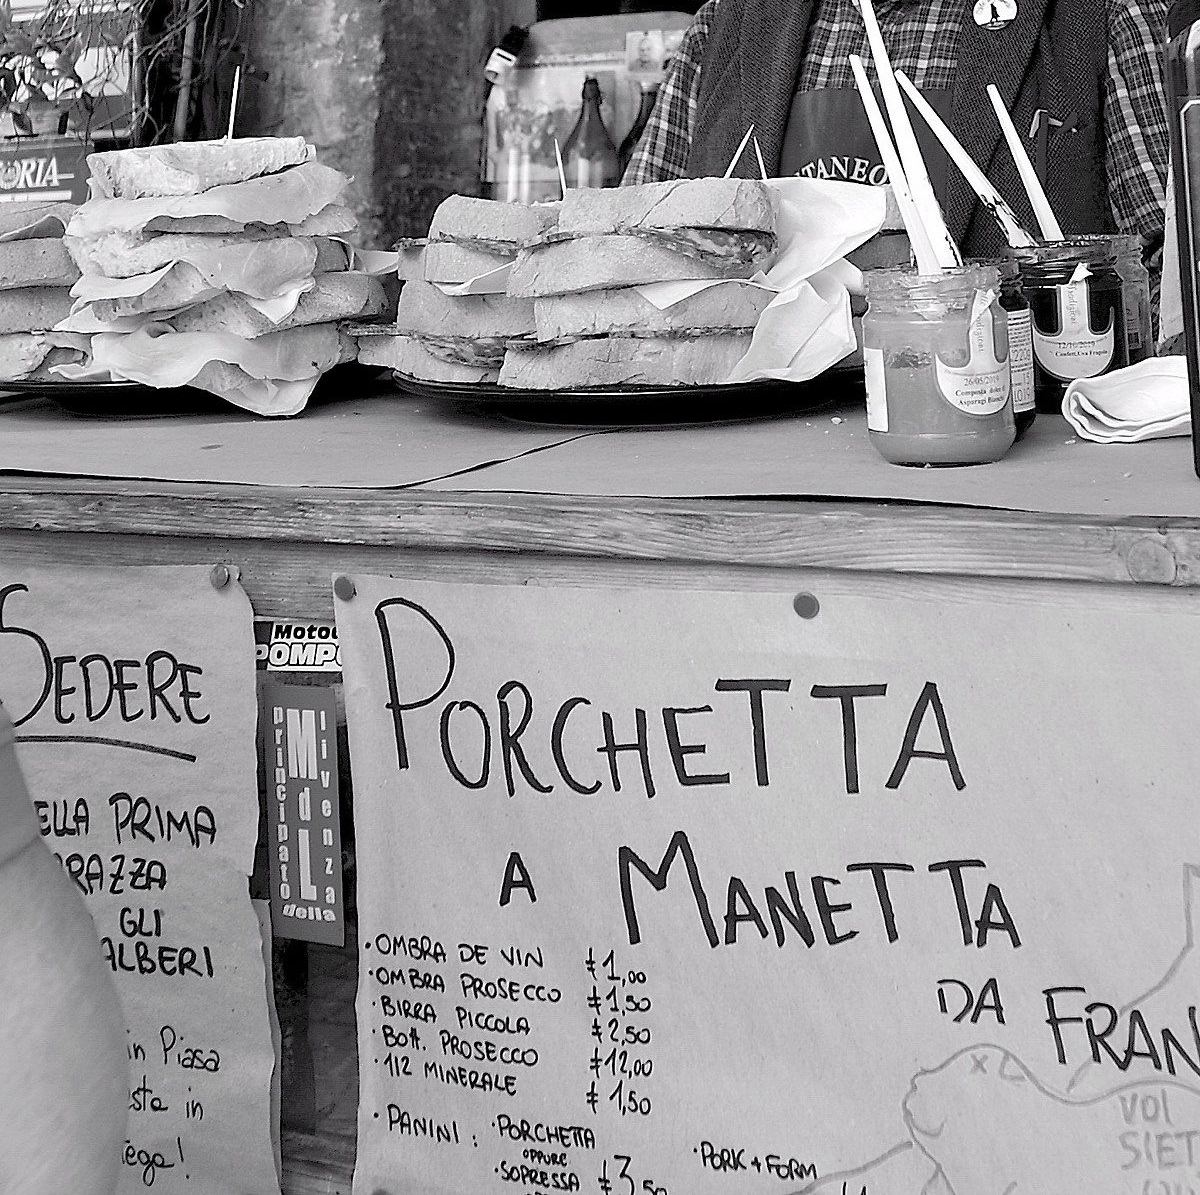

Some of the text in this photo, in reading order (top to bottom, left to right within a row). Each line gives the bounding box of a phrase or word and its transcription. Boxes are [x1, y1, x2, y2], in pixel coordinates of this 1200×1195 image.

[0, 157, 60, 190] ORIA
[794, 155, 889, 186] TANEO
[0, 583, 210, 728] SEDERE
[255, 642, 341, 667] POMP
[376, 597, 967, 798] PORCHETTA
[108, 791, 217, 848] PRIMA
[55, 852, 168, 895] RAZZA
[499, 830, 1023, 949] A MANETTA
[119, 906, 163, 938] GLI
[282, 904, 336, 922] della
[100, 936, 214, 977] ALBERI
[375, 933, 447, 964] OMBRA
[458, 943, 489, 965] DE
[500, 946, 544, 968] VIN
[376, 966, 445, 993] OMBRA
[460, 973, 562, 1003] PROSECCO
[936, 977, 1006, 1025] DA
[380, 994, 437, 1024] BIRRA
[455, 1006, 531, 1036] PICCOLA
[159, 1025, 221, 1072] Piasa
[439, 1029, 539, 1067] PROSECCO
[424, 1060, 517, 1096] MINERALE
[186, 1085, 203, 1120] in
[1118, 1089, 1173, 1127] VOI
[496, 1114, 596, 1149] PORCHETTA
[500, 1160, 580, 1192] SOPRESSA
